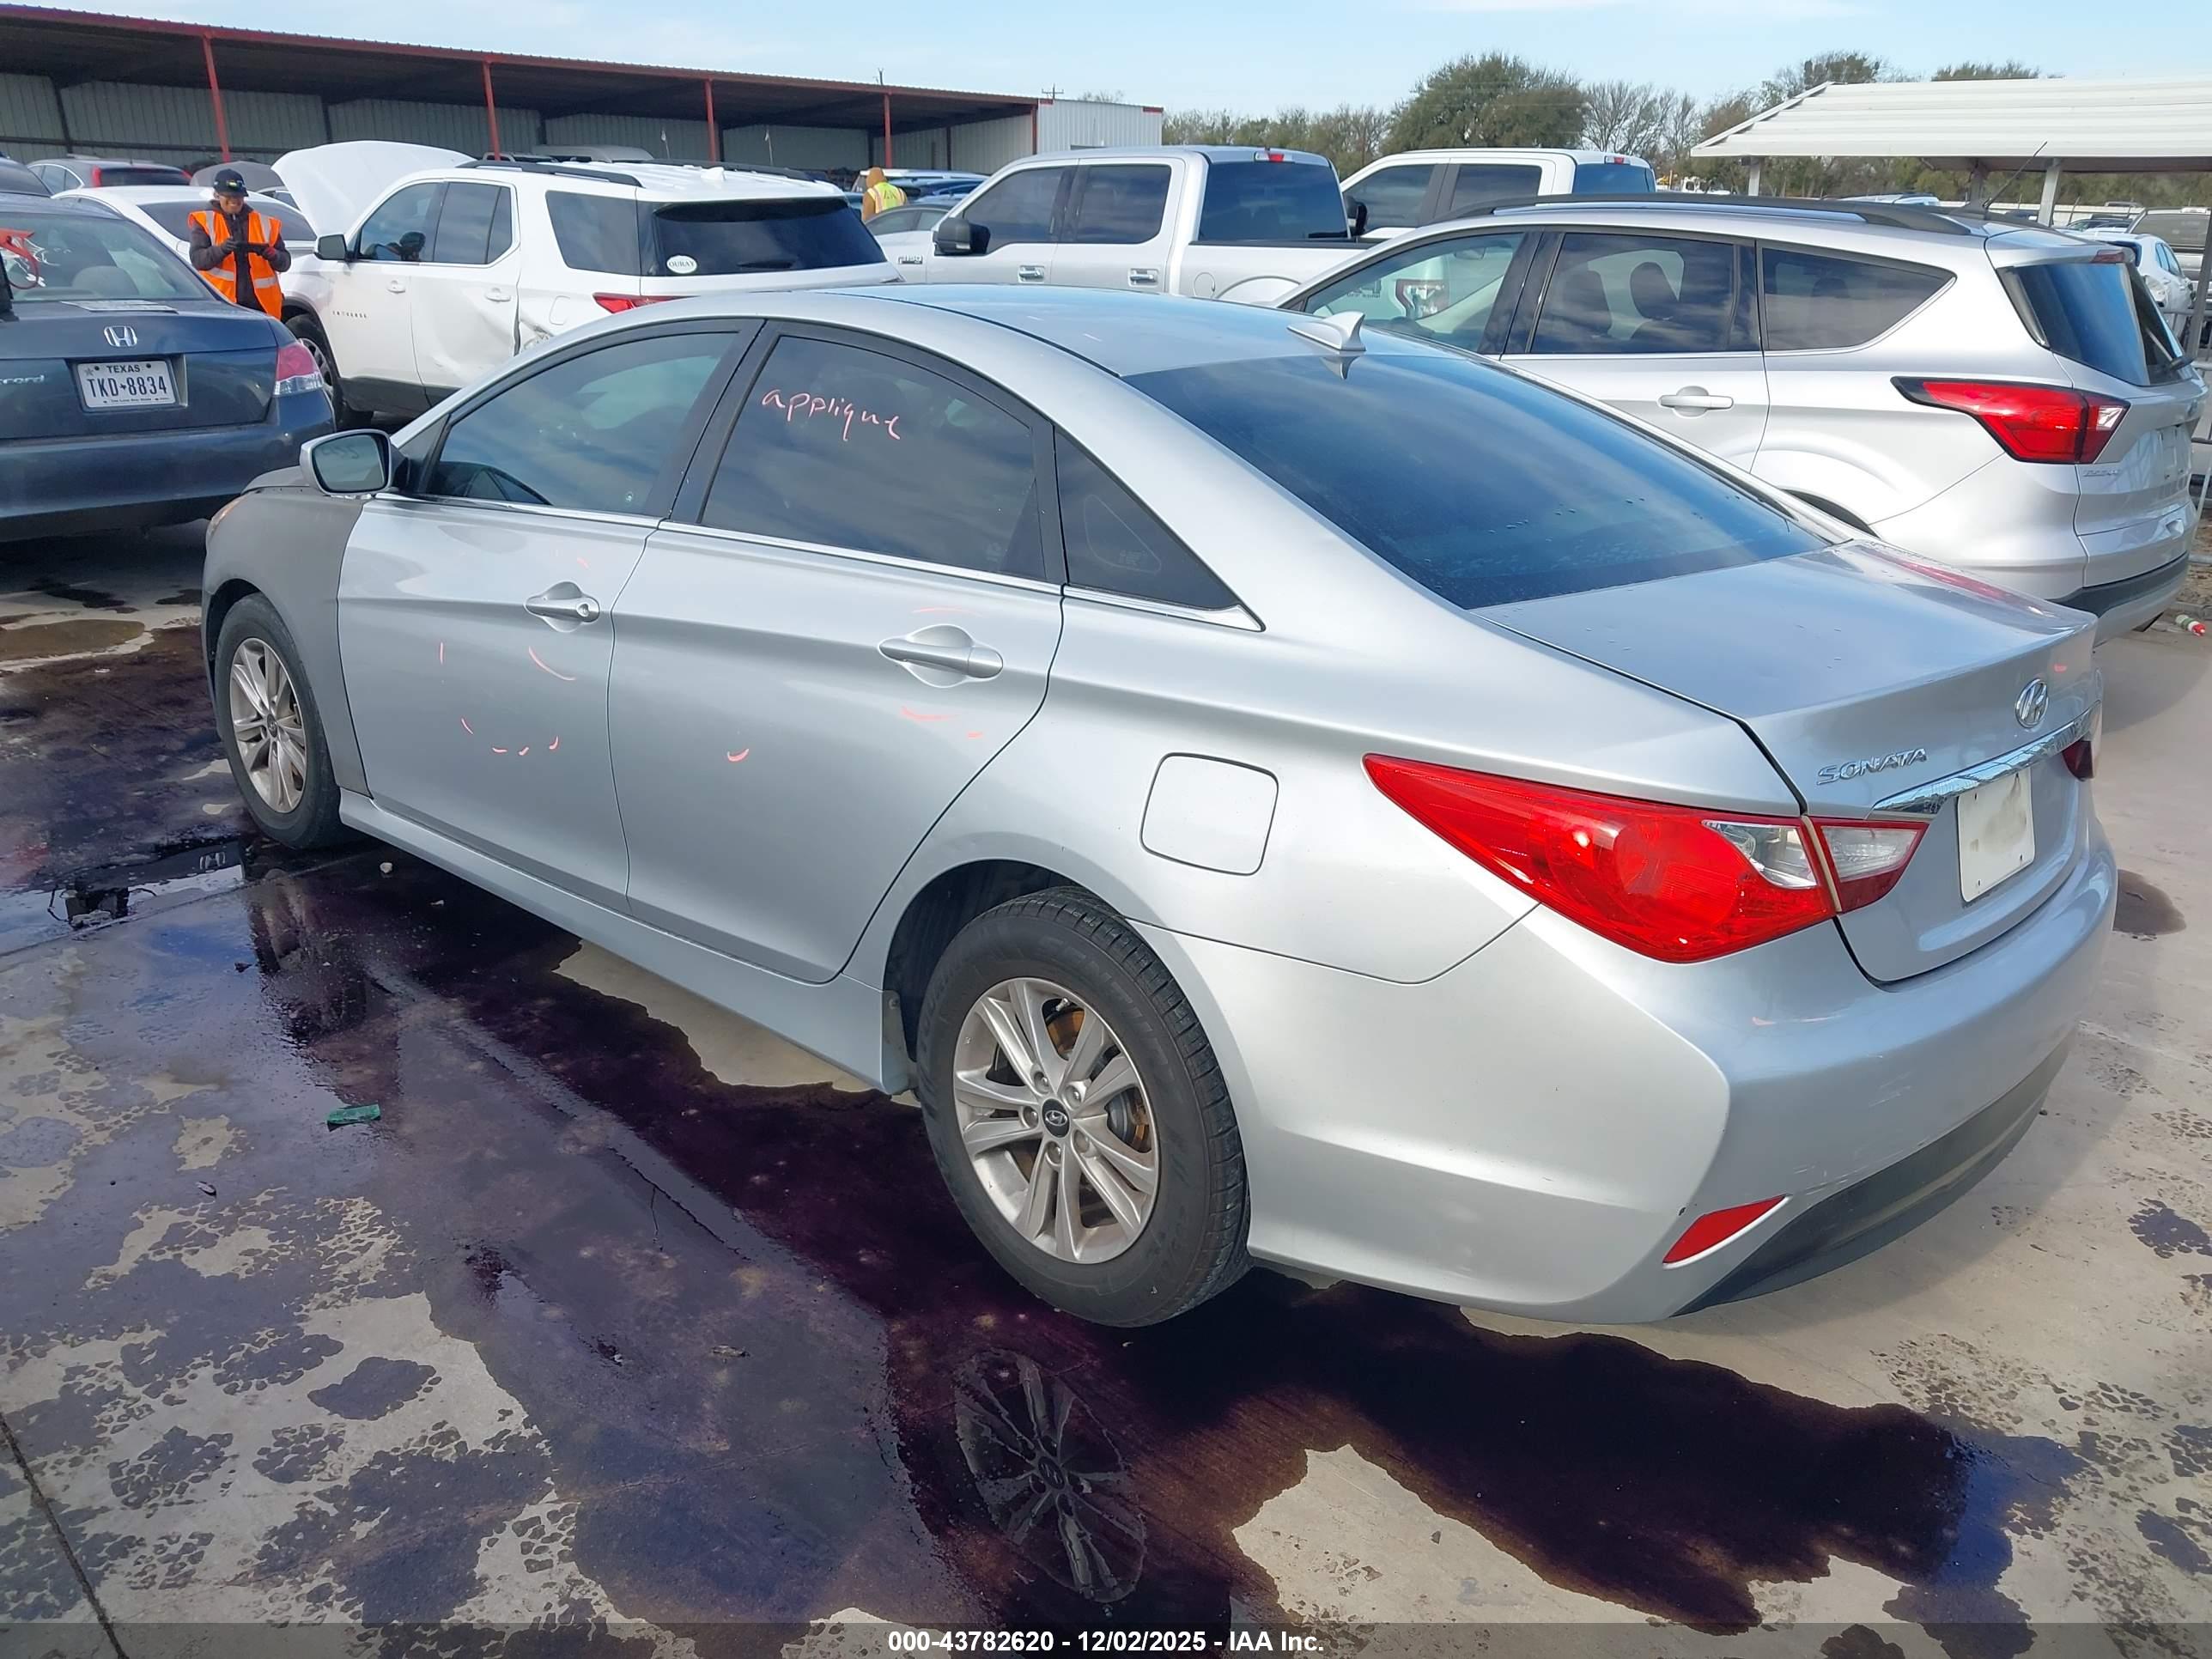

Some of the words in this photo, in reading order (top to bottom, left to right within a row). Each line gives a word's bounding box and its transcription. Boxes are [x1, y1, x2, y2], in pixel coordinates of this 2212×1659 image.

[106, 364, 141, 374] TEXAS
[762, 389, 901, 441] applique
[1816, 748, 1928, 786] SONATA
